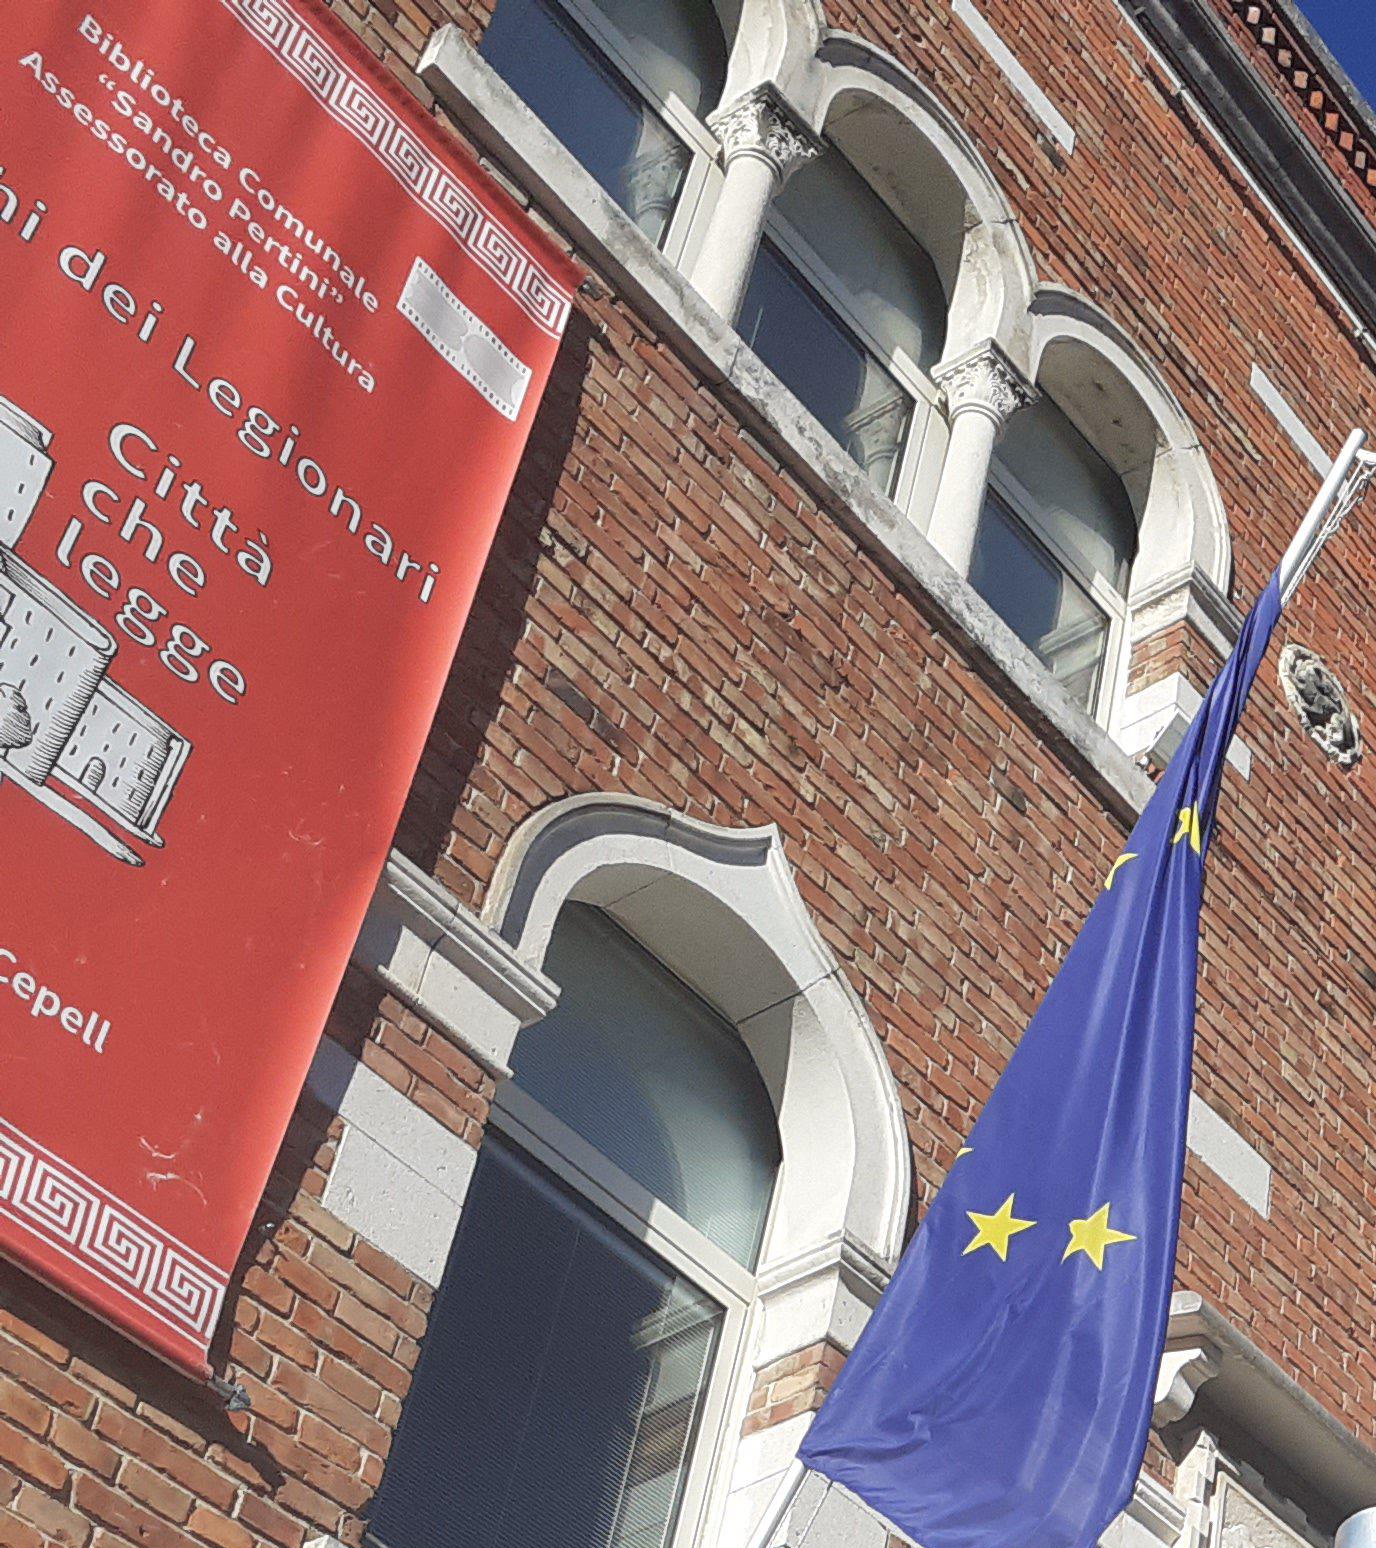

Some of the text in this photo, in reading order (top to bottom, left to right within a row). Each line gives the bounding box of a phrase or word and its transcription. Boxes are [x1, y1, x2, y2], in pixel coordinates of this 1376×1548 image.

[18, 51, 208, 230] Assessorato
[213, 230, 269, 290] alla
[275, 284, 375, 394] Cultura
[78, 14, 379, 313] Biblioteca Comunale
[59, 246, 162, 342] dei
[174, 336, 439, 603] Legionari
[80, 479, 207, 598] che
[107, 422, 273, 587] Città
[57, 517, 245, 704] legge
